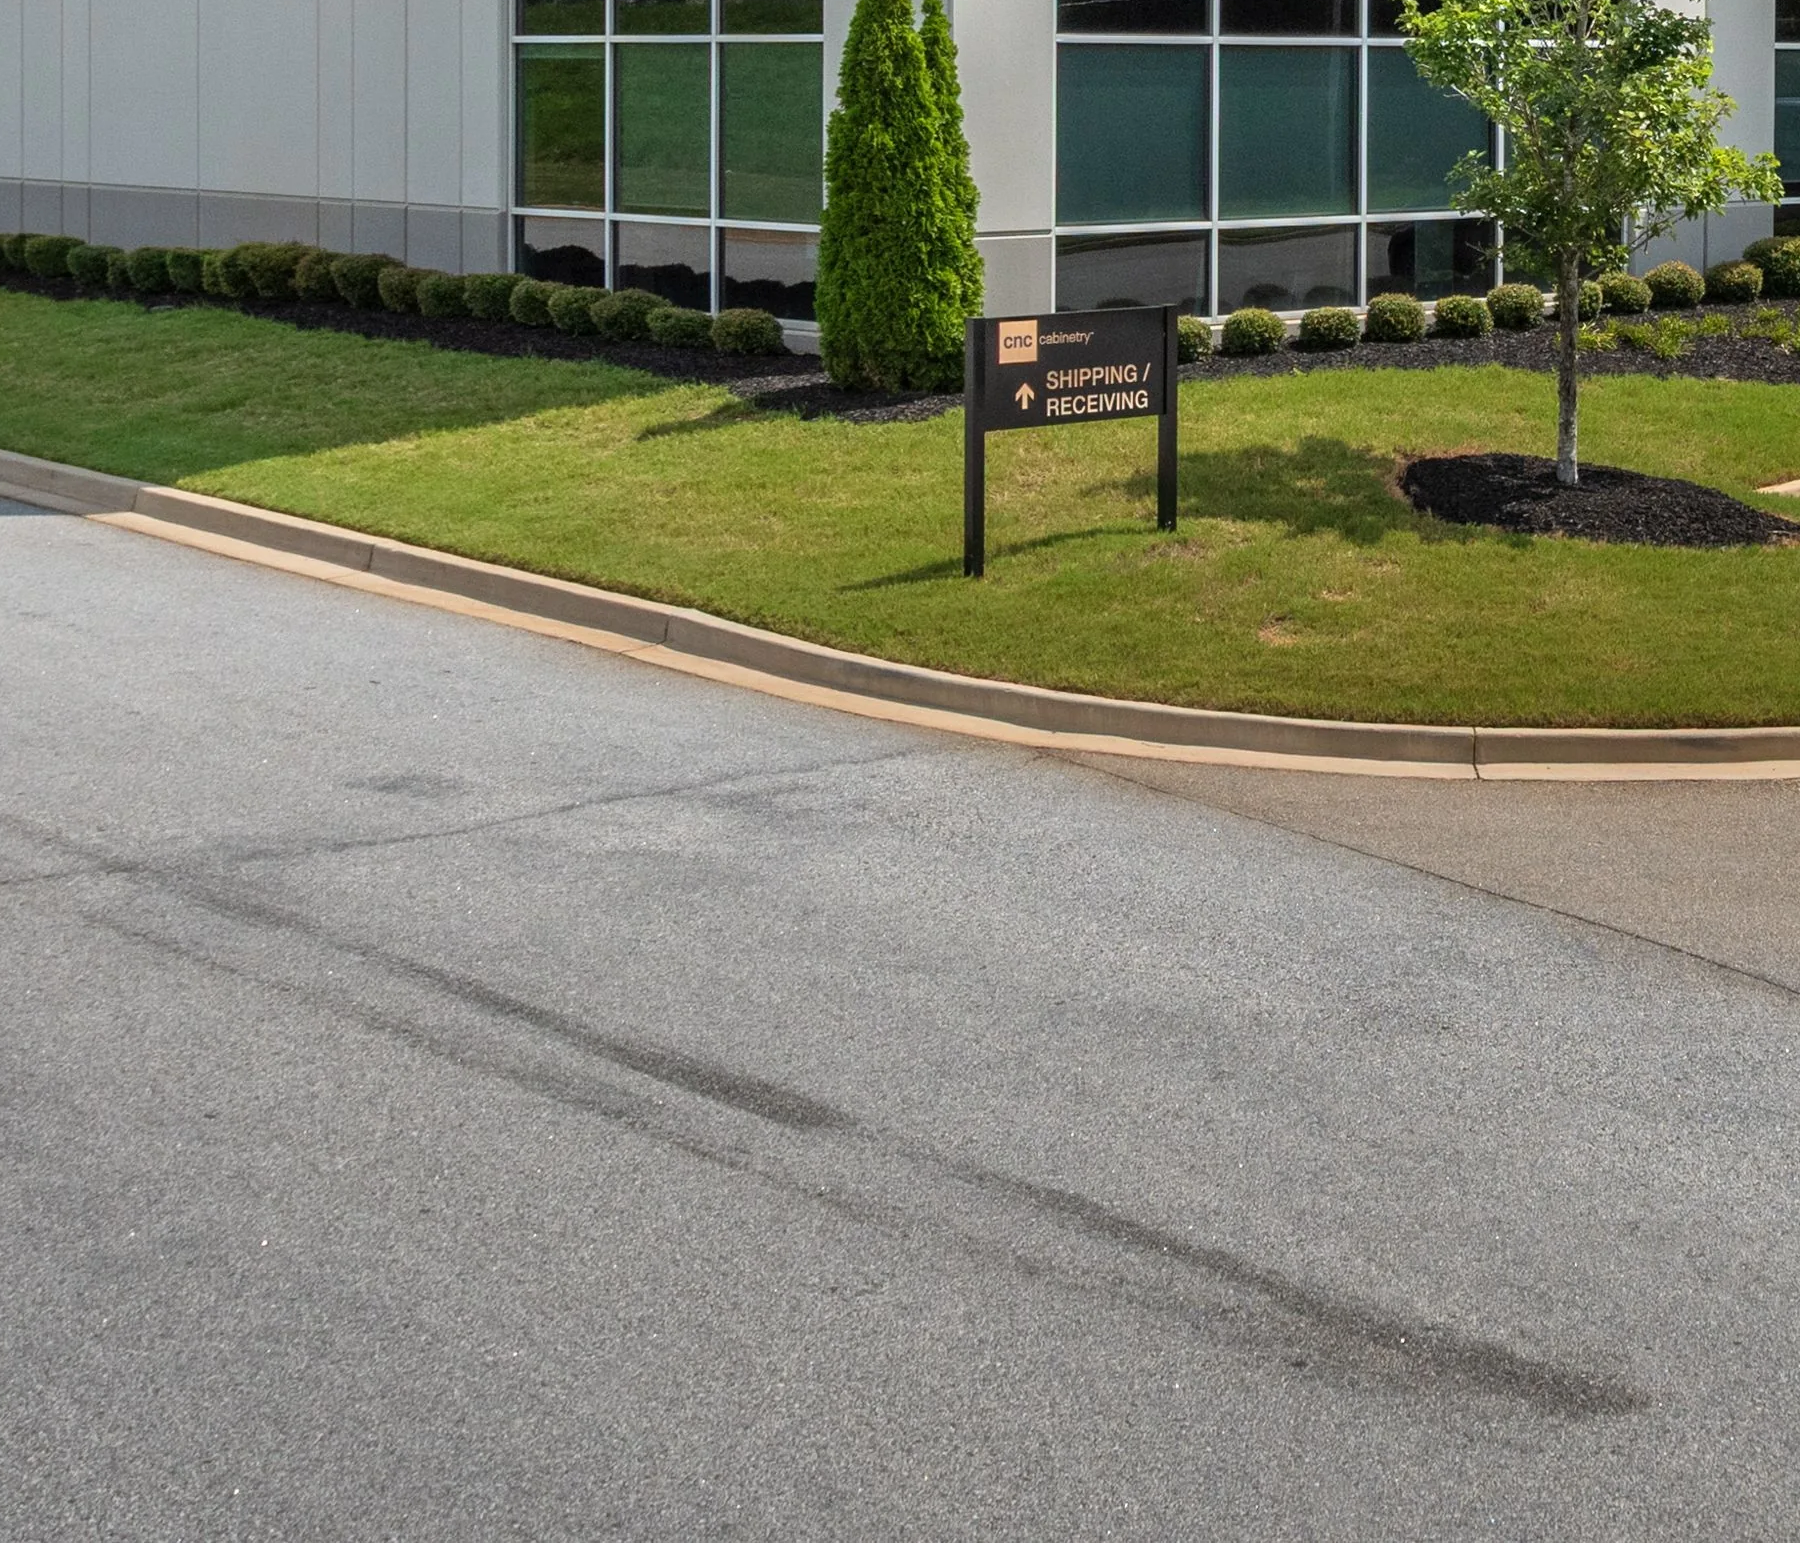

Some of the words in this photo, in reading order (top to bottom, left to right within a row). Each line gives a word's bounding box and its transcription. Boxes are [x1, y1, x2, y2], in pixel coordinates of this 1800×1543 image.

[1003, 333, 1033, 350] cnc
[1039, 332, 1092, 346] cabinetry
[1046, 364, 1138, 390] SHIPPING
[1142, 362, 1151, 383] /
[1046, 390, 1149, 417] RECEIVING
